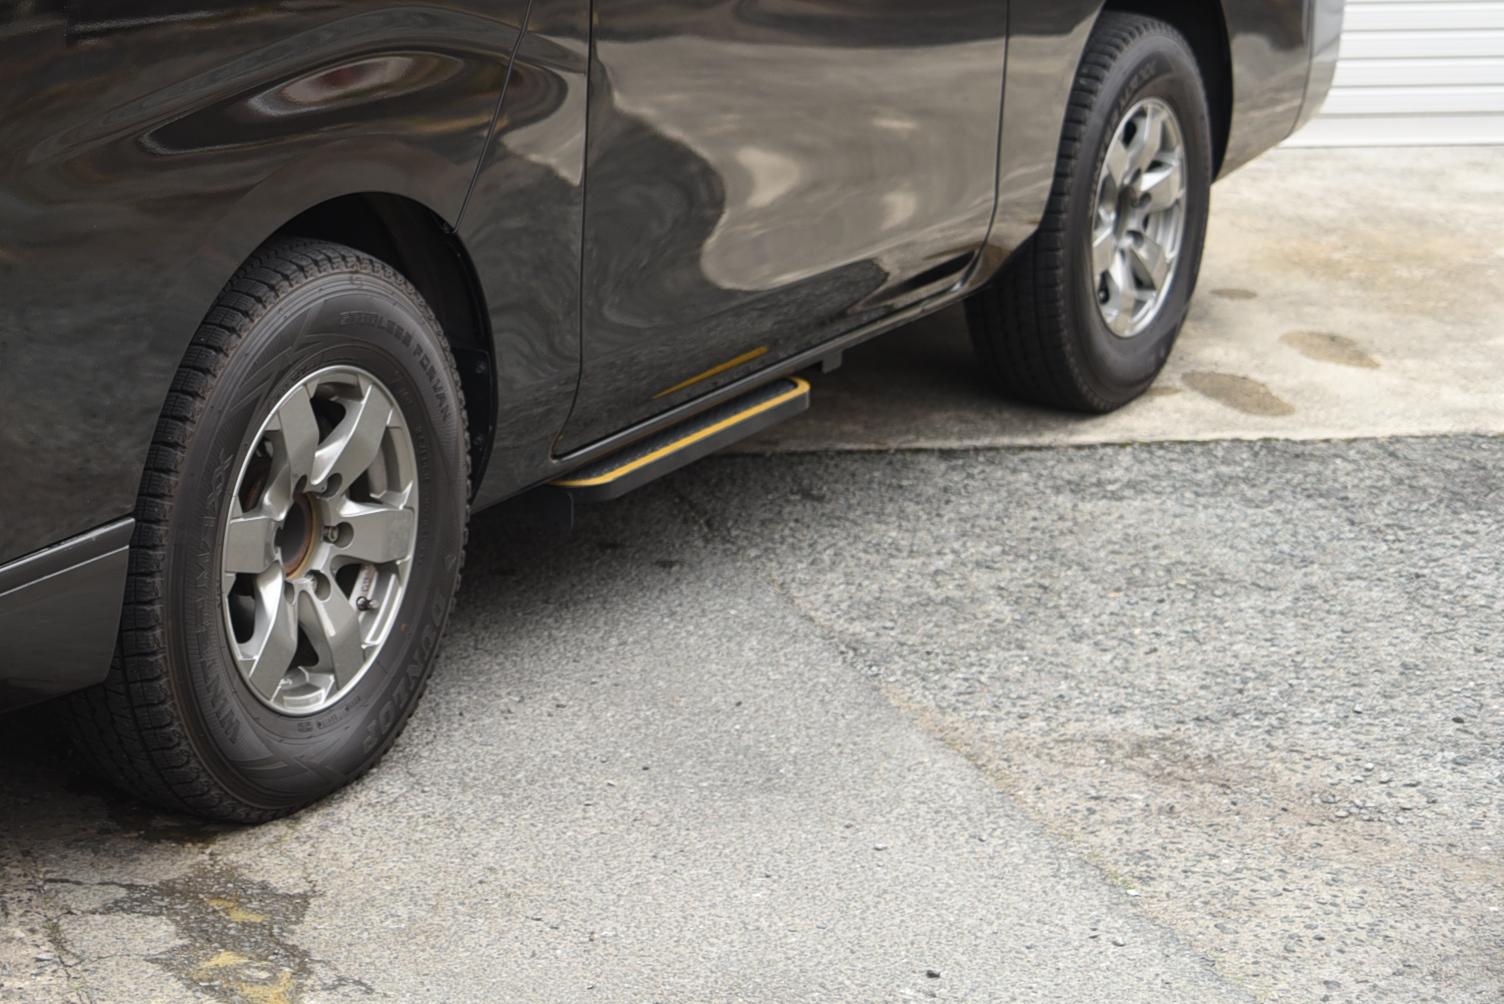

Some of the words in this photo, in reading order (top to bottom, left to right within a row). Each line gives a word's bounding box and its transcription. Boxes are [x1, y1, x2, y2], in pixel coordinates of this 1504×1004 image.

[196, 448, 234, 589] MAXX
[195, 596, 241, 744] WINTER
[362, 588, 446, 755] DUNLOP
